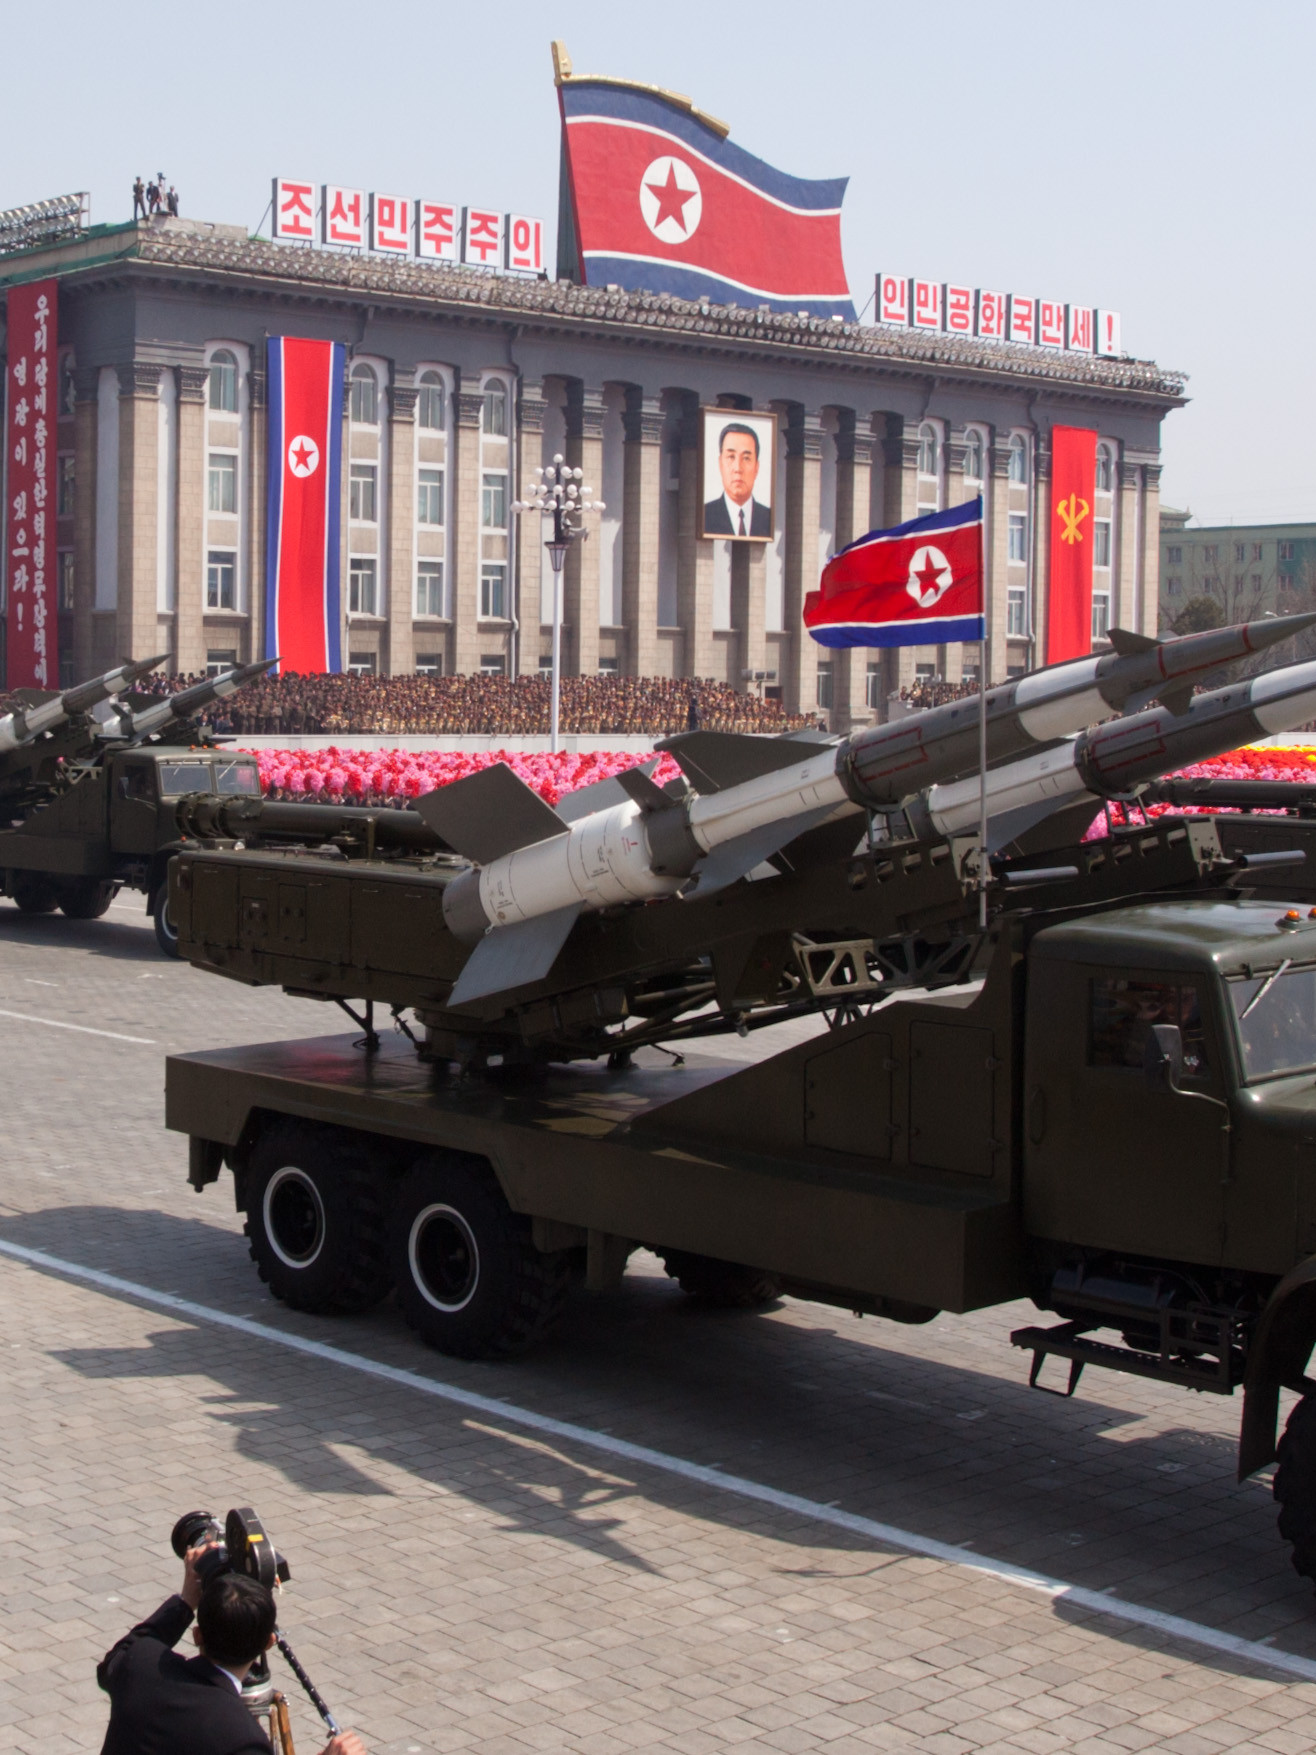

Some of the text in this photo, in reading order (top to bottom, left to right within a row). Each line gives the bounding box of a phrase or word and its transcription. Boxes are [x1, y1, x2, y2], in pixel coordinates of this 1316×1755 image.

[280, 182, 541, 269] 조선민주주의
[883, 277, 1114, 352] 인민공화국만세!
[11, 356, 30, 632] 영광이 있으라!
